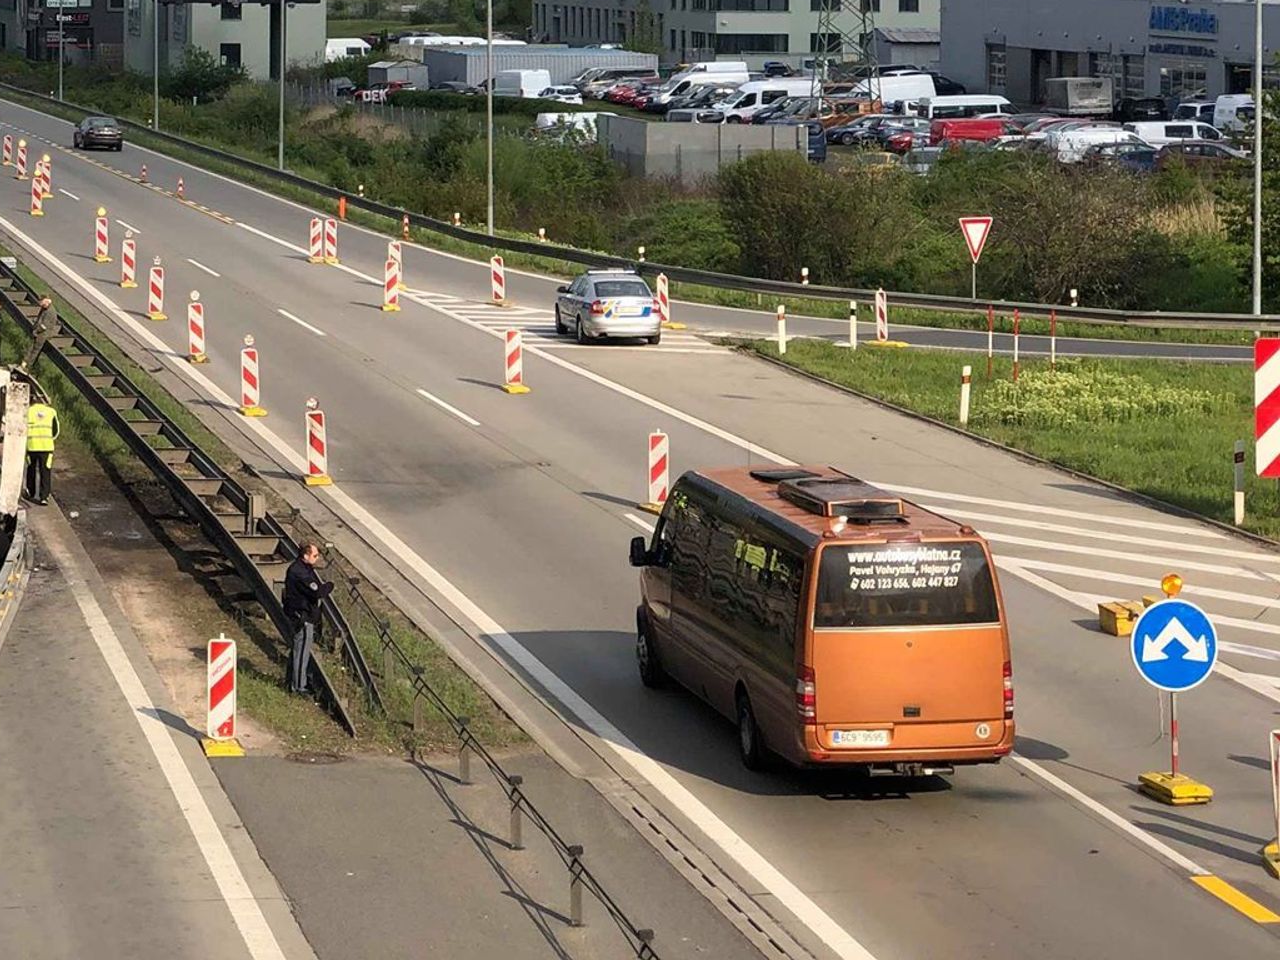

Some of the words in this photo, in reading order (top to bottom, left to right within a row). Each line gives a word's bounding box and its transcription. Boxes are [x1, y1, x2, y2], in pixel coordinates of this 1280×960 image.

[848, 547, 961, 565] www.autobusyblatna.cz
[849, 565, 874, 576] Pavel
[951, 562, 962, 573] 67
[860, 579, 875, 589] 602
[877, 578, 892, 589] 123
[912, 577, 926, 588] 602
[927, 577, 942, 588] 447
[944, 576, 959, 587] 827
